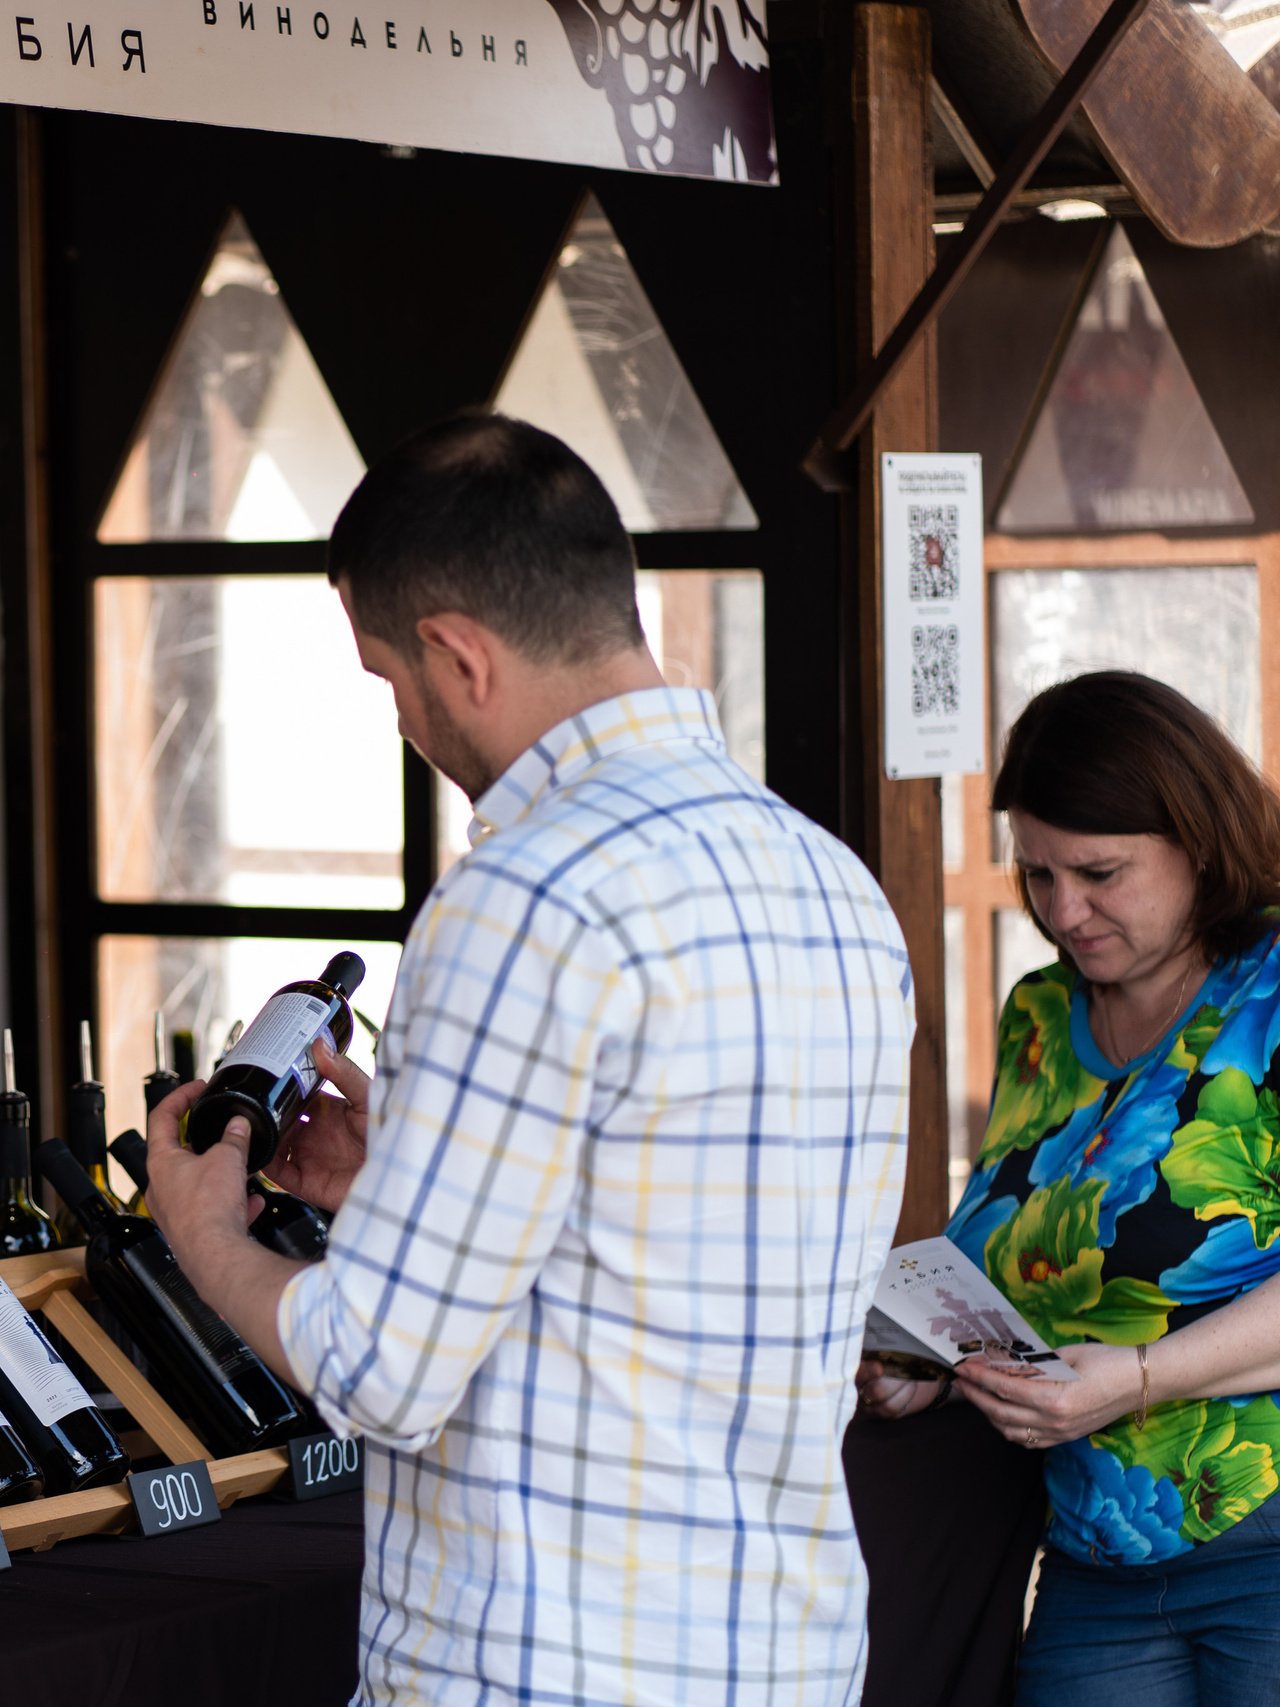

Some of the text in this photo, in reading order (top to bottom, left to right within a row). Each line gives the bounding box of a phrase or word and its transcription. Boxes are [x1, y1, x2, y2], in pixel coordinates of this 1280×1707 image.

[202, 0, 528, 67] ВИНОДЕЛЬНЯ
[888, 1264, 955, 1291] ТАБИЯ
[302, 1436, 359, 1486] 1200
[150, 1471, 204, 1528] 900
